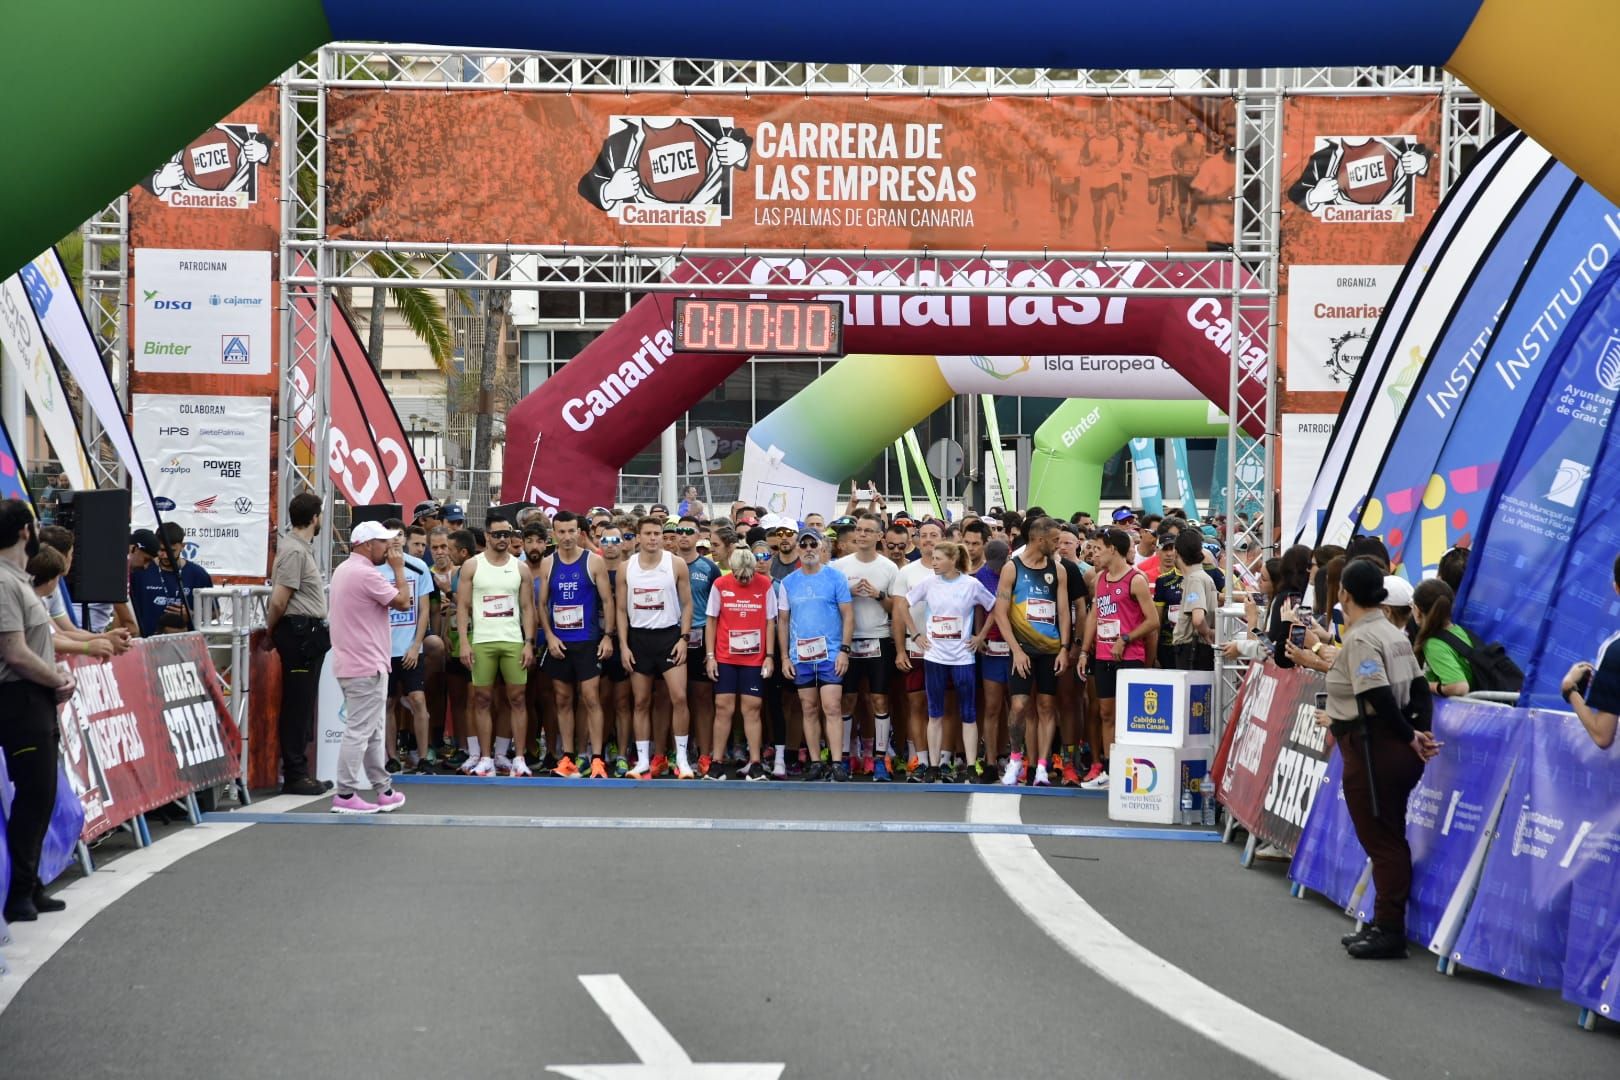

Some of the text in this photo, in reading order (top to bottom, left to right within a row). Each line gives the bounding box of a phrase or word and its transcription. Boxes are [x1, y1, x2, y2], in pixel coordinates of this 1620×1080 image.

[756, 121, 943, 160] CARRERA DE
[193, 147, 230, 169] #C7CE
[652, 149, 697, 175] #C7CE
[1348, 160, 1387, 183] #C7CE
[755, 165, 977, 202] LAS EMPRESAS
[171, 191, 246, 209] Canarias7
[622, 204, 716, 226] Canarias7
[754, 207, 974, 227] LAS PALMAS DE GRAN CANARIA
[179, 260, 228, 272] PATROCINAN
[1336, 277, 1377, 288] ORGANIZA
[223, 295, 263, 307] cajamar
[1495, 243, 1609, 391] INSTITUTO
[143, 341, 192, 356] Binter
[1043, 356, 1074, 371] Isla
[1080, 357, 1155, 373] Europea
[179, 404, 226, 415] COLABORAN
[1560, 394, 1575, 405] de
[1580, 400, 1598, 413] Las
[1556, 404, 1570, 415] de
[1572, 409, 1596, 424] Gran
[159, 426, 190, 436] HPS
[1060, 406, 1102, 448] Binter
[203, 460, 242, 470] POWER
[220, 469, 241, 478] ADE
[198, 528, 240, 538] SOLIDARIO
[558, 581, 578, 591] PEPE
[563, 591, 575, 600] EU
[1130, 722, 1170, 731] Gran Canaria
[1133, 715, 1166, 724] Cabildo de
[163, 700, 225, 770] START
[1128, 802, 1160, 811] DEPORTES
